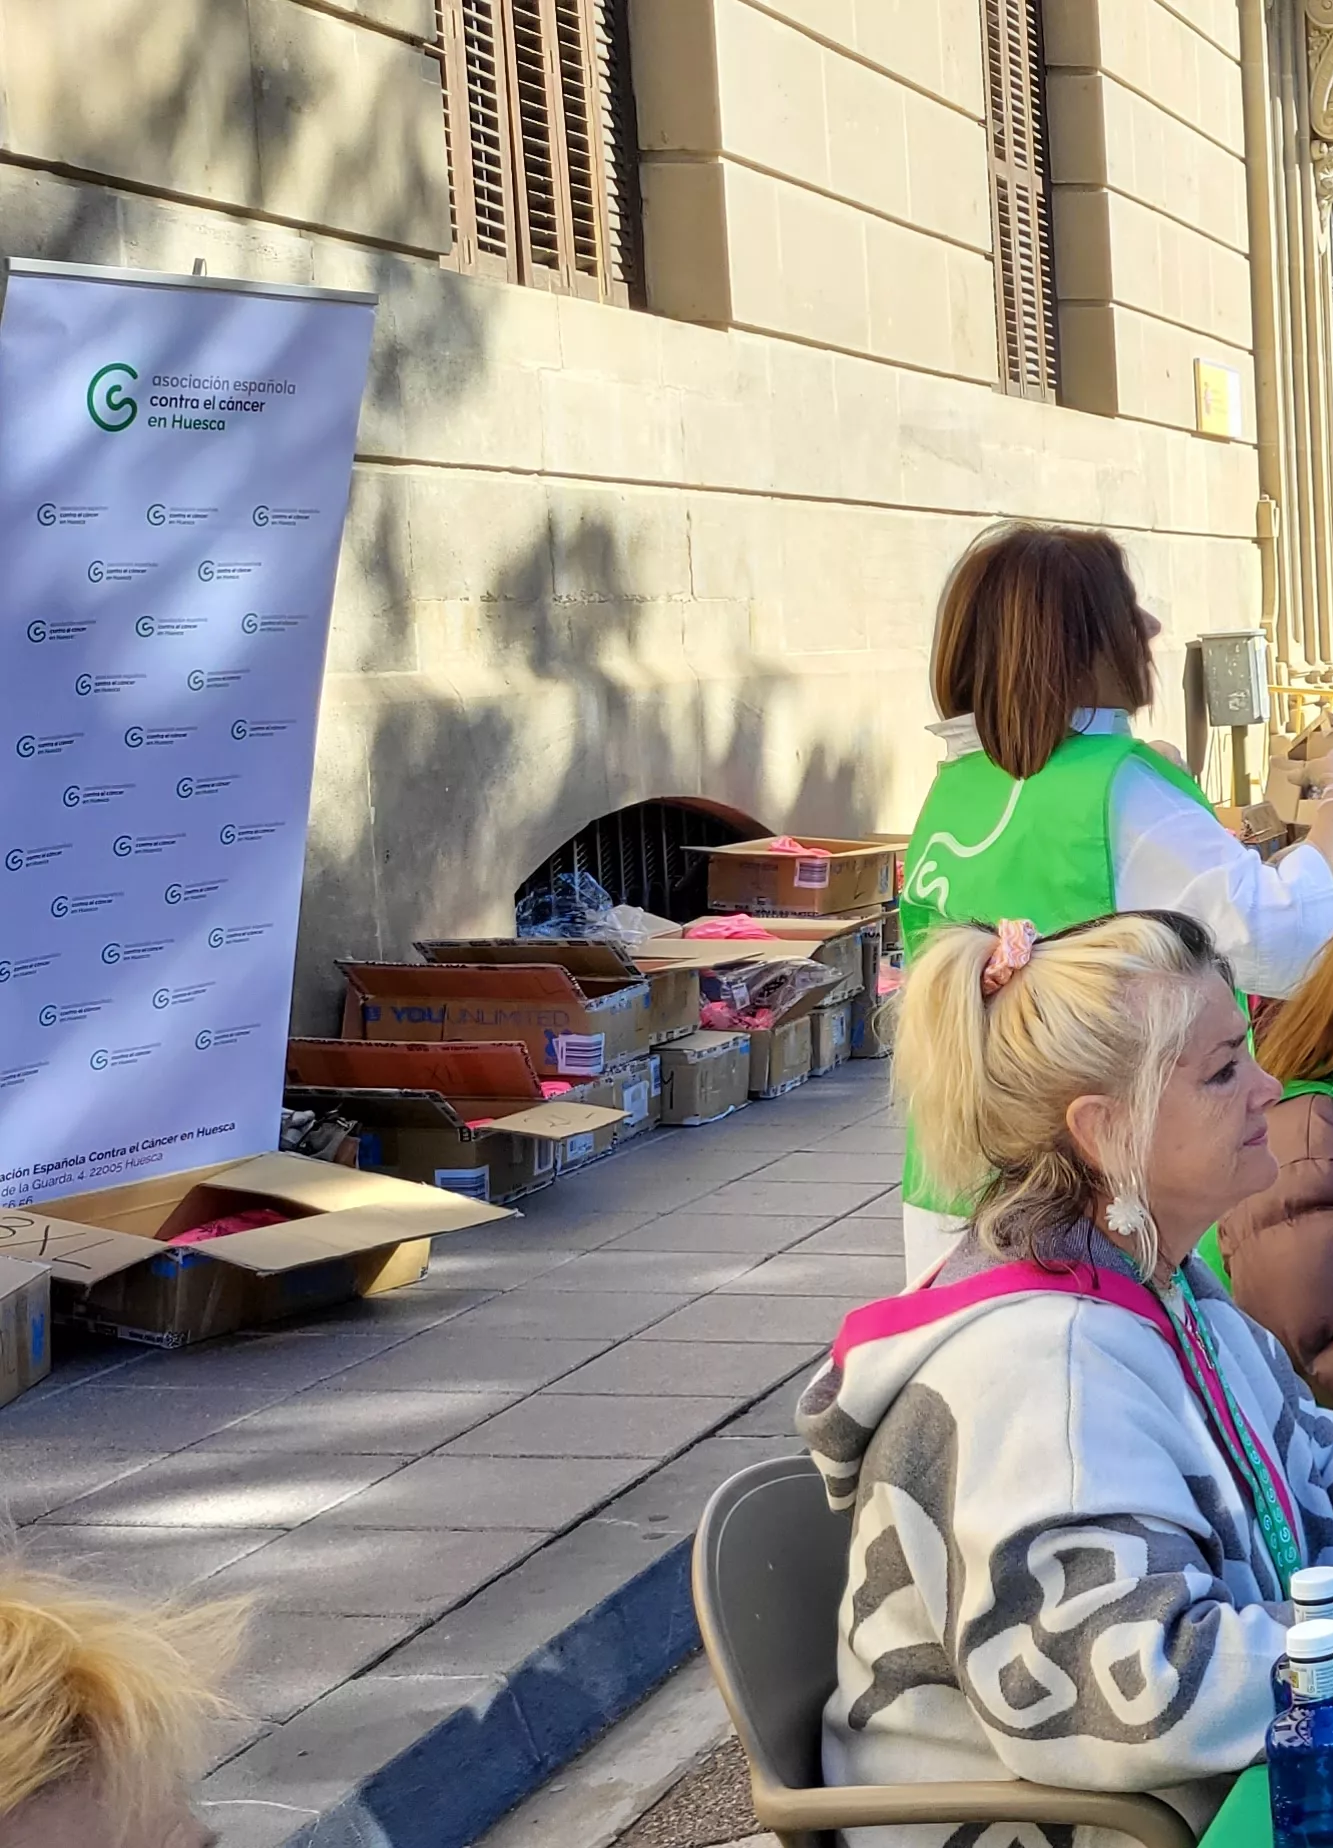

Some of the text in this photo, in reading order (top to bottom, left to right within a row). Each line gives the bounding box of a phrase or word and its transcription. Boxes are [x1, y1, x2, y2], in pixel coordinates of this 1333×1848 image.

[152, 374, 296, 396] asociación española
[150, 394, 266, 412] contra el cáncer
[148, 414, 226, 430] en Huesca
[446, 1008, 570, 1027] UNLIMITED
[33, 1155, 86, 1177] Española
[89, 1147, 127, 1163] Contra
[129, 1143, 140, 1155] el
[141, 1135, 178, 1151] Cáncer
[180, 1131, 195, 1142] en
[196, 1121, 236, 1138] Huesca
[1, 1186, 16, 1198] de
[18, 1183, 29, 1194] la
[89, 1161, 123, 1178] 22005
[125, 1151, 163, 1169] Huesca
